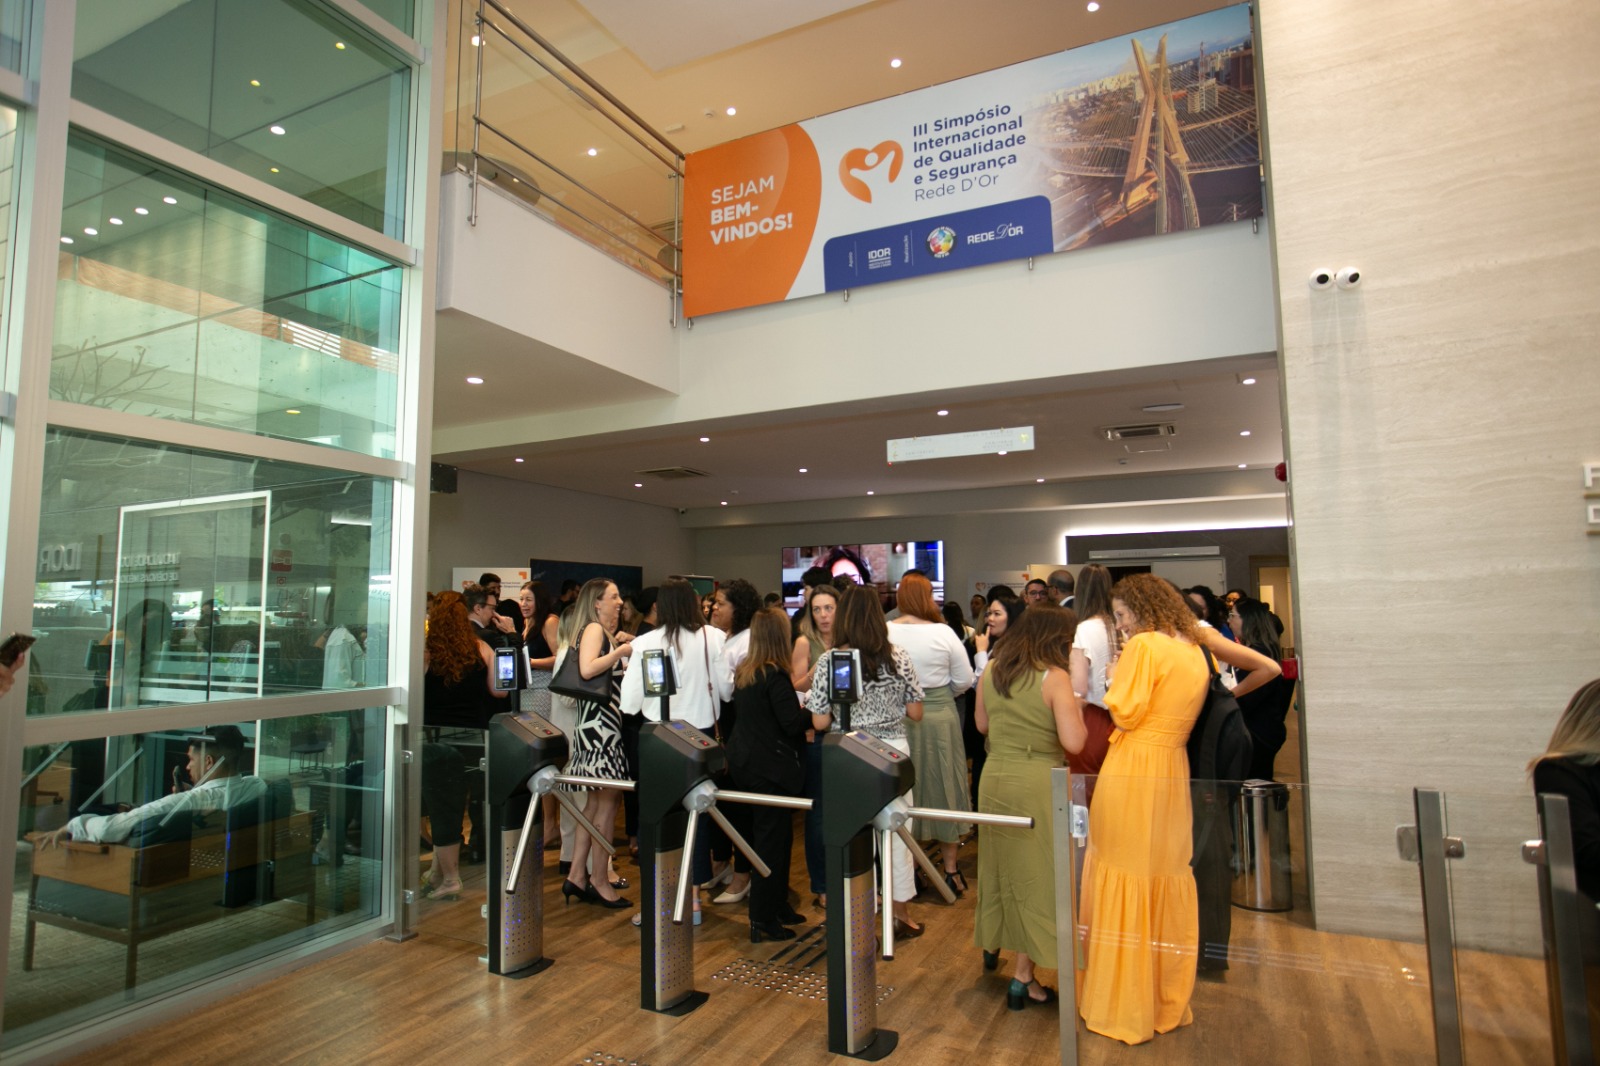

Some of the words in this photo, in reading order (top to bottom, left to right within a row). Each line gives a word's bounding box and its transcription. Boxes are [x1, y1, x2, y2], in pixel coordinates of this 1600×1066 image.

[913, 122, 928, 138] III
[933, 104, 1012, 132] Simpósio
[913, 115, 1023, 153] Internacional
[913, 155, 934, 169] de
[938, 133, 1027, 163] Qualidade
[913, 174, 924, 185] e
[928, 153, 1018, 182] Segurança
[711, 174, 775, 205] SEJAM
[914, 183, 956, 202] Rede
[961, 173, 1000, 192] D'Or
[710, 200, 759, 226] BEM-
[710, 212, 793, 246] VINDOS!
[966, 230, 995, 245] REDE
[868, 247, 891, 260] IDOR
